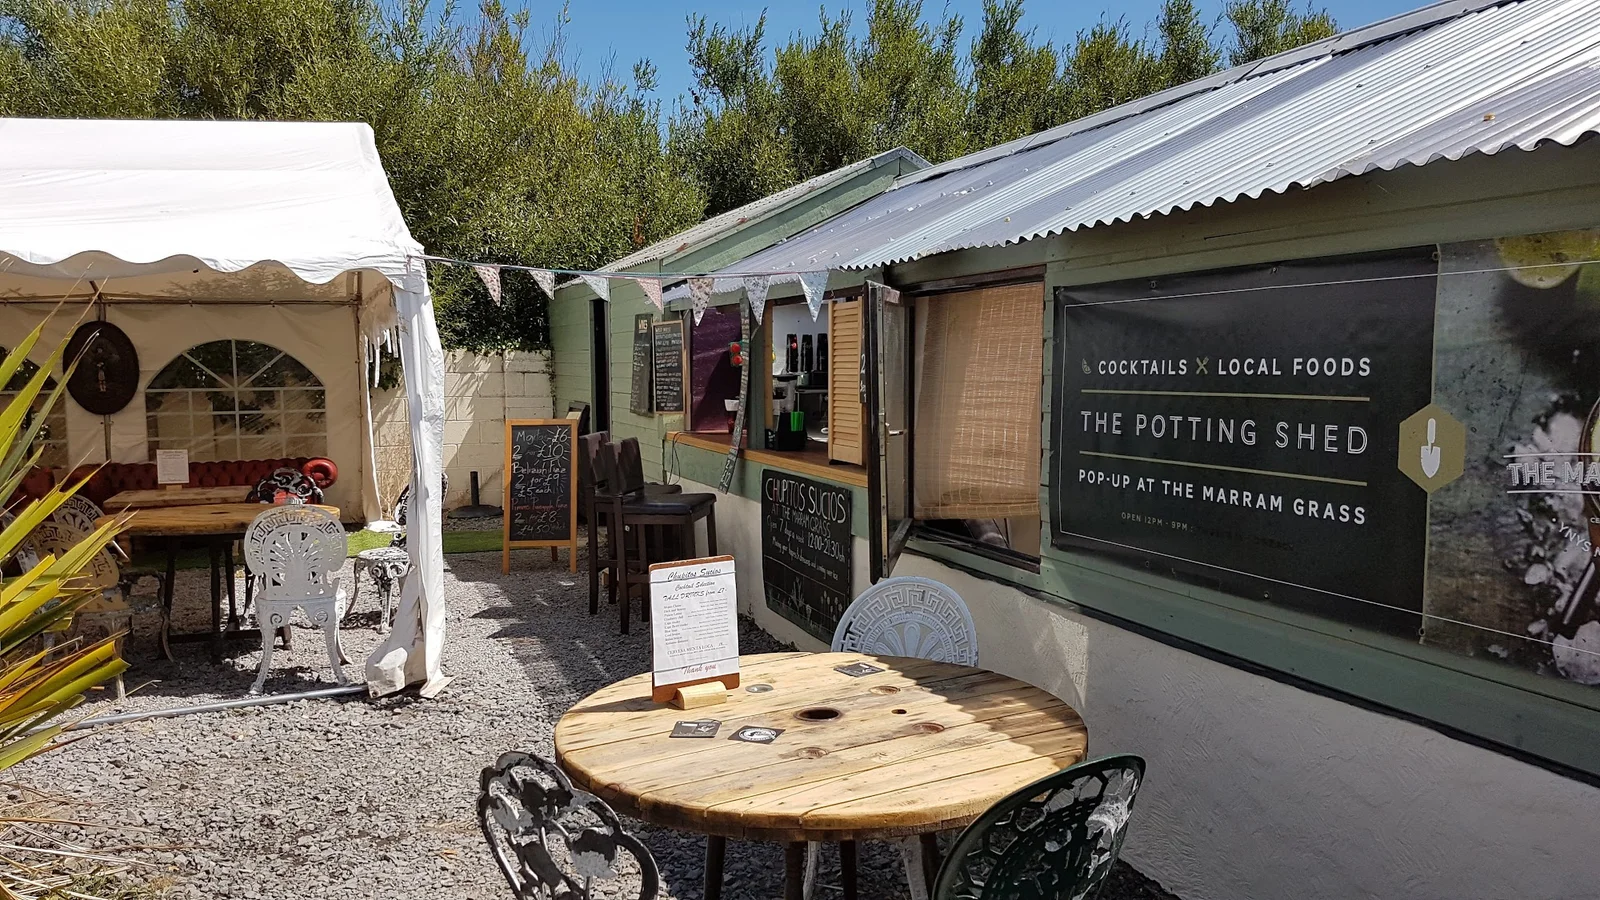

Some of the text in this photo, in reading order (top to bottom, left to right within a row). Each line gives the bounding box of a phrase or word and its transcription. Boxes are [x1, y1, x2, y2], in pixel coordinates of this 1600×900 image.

[1098, 357, 1371, 376] COCKTAILS LOCAL FOODS
[1080, 410, 1368, 454] THE POTTING SHED
[512, 444, 522, 458] 2
[1506, 462, 1556, 486] THE
[765, 478, 846, 524] CHUPITOS SUCIOS
[1078, 469, 1366, 525] POP-UP AT THE MARRAM GRASS
[514, 512, 522, 523] 2
[772, 503, 780, 516] AT
[782, 504, 790, 520] THE
[810, 516, 831, 538] GRASS
[780, 518, 784, 532] 7
[1122, 512, 1141, 522] OPEN
[1144, 516, 1162, 527] 12PM
[1171, 522, 1188, 532] 9PM
[1558, 522, 1592, 552] YNYS
[681, 664, 717, 674] Thank you
